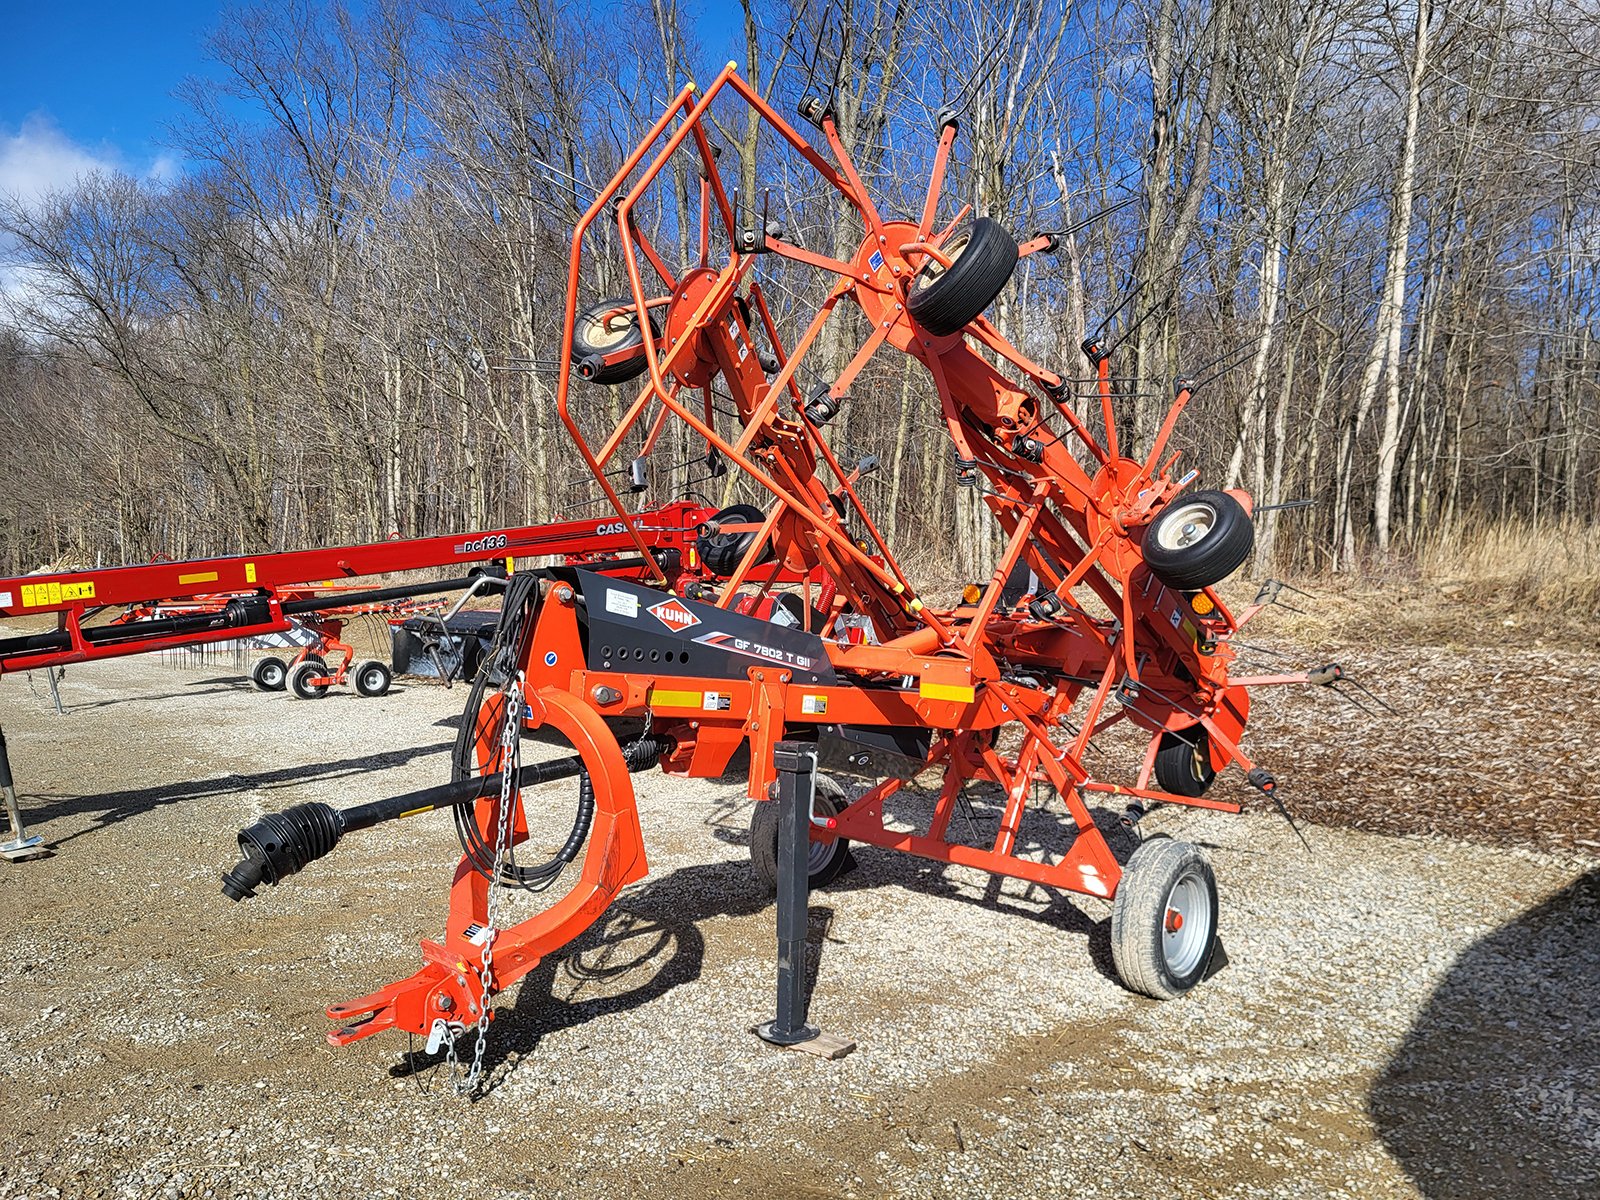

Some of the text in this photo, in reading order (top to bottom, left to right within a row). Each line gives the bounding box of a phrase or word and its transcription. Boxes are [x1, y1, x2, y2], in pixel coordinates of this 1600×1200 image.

[464, 534, 507, 552] DC133
[656, 607, 692, 625] KUHN
[735, 638, 750, 651] GF
[754, 644, 783, 660] 7802
[786, 653, 794, 663] T
